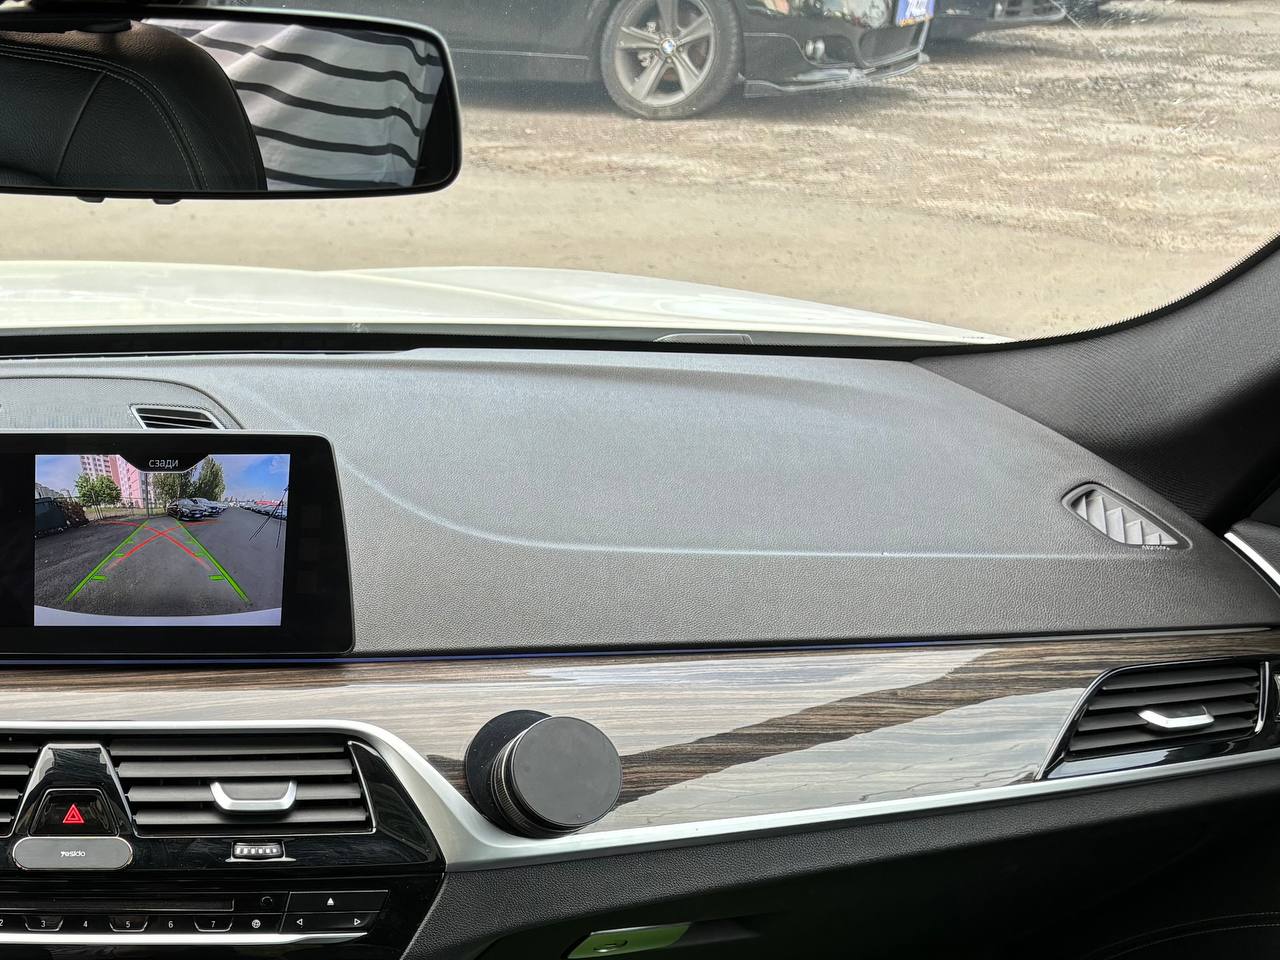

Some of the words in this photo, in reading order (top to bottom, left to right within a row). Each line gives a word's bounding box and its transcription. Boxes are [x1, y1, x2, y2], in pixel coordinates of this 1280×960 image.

[148, 459, 179, 469] сзади
[40, 919, 46, 928] 3
[82, 920, 88, 928] 4
[125, 920, 131, 928] 5
[168, 920, 174, 928] 6
[211, 920, 216, 928] 7
